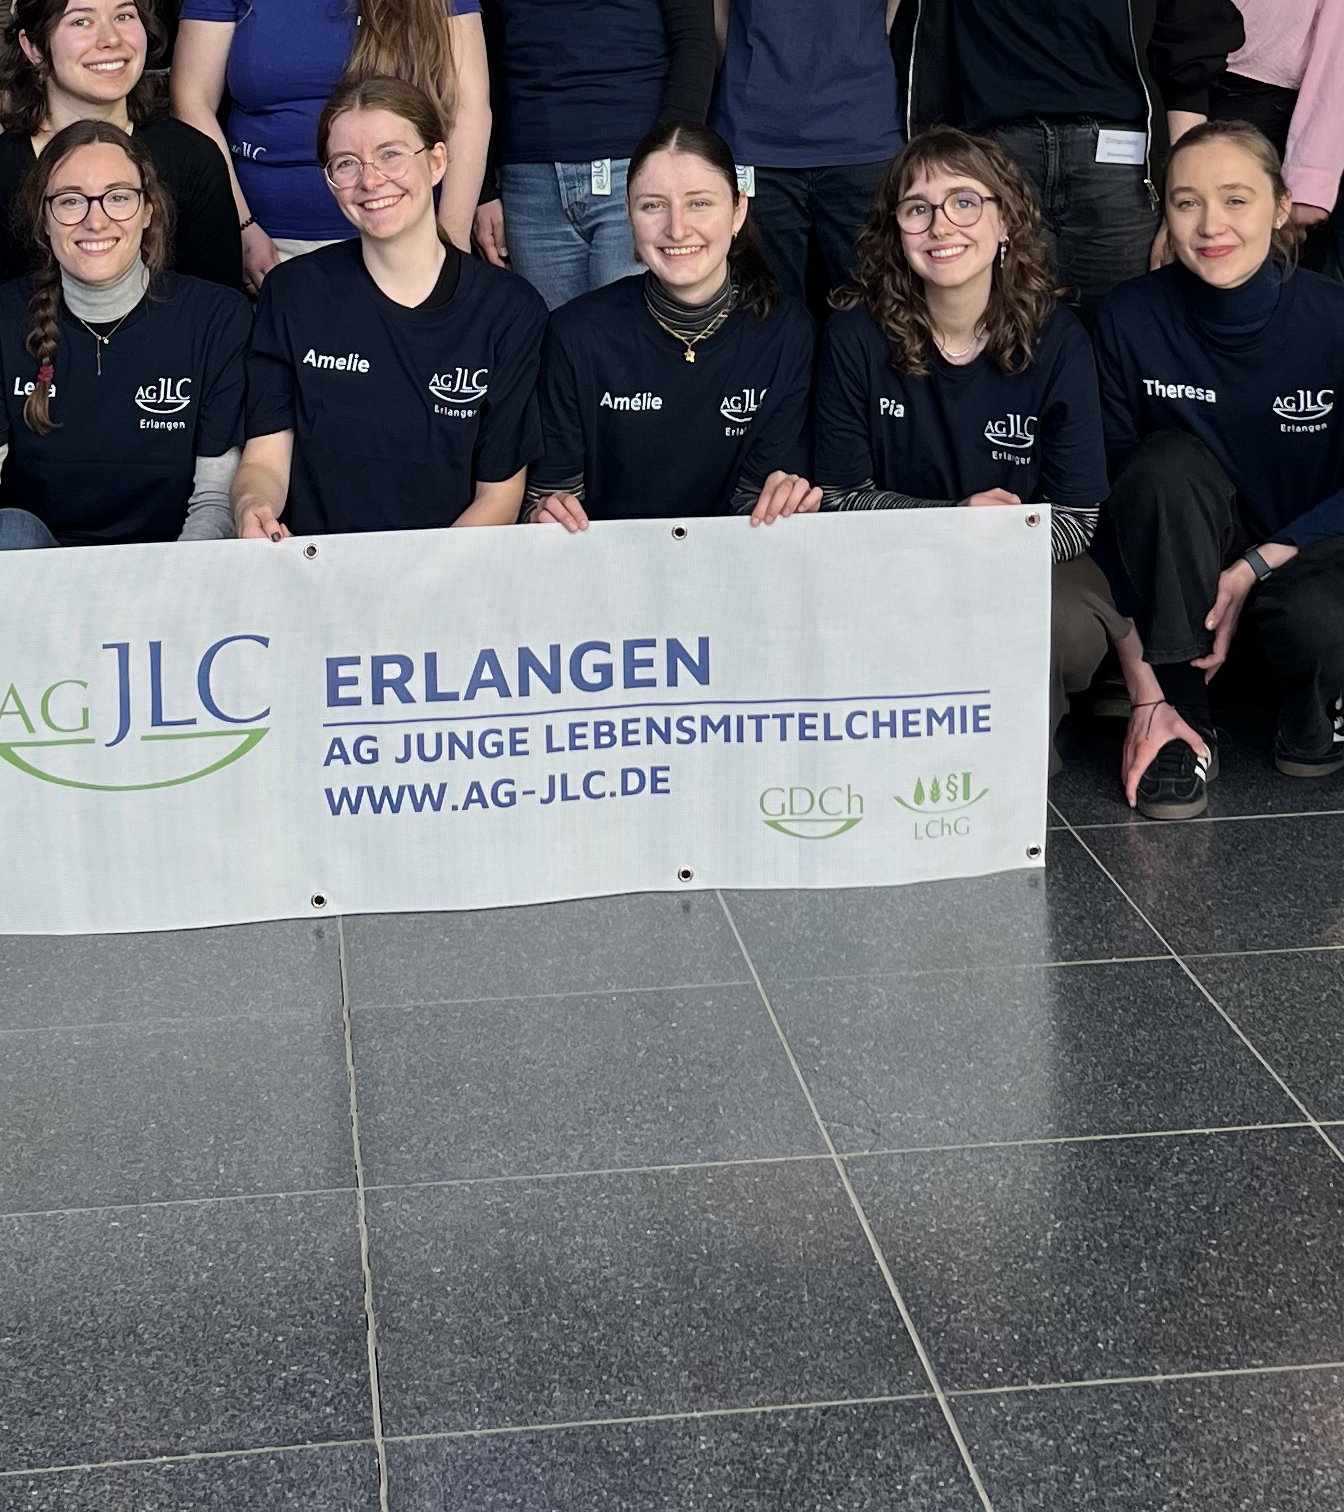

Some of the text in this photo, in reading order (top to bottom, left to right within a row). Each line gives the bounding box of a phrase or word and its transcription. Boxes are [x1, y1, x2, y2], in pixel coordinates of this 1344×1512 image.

[303, 349, 371, 373] Amelie
[13, 377, 57, 398] Lea
[1142, 379, 1216, 403] Theresa
[599, 392, 664, 412] Amélie
[879, 397, 905, 418] Pia
[139, 419, 186, 431] Erlangen
[1280, 422, 1328, 433] Erlangen
[325, 636, 710, 708] ERLANGEN
[322, 703, 992, 767] AG JUNGE LEBENSMITTELCHEMIE
[324, 765, 672, 817] WWW.AG-JLC.DE
[759, 784, 865, 817] GDCh
[914, 816, 971, 841] LChG
